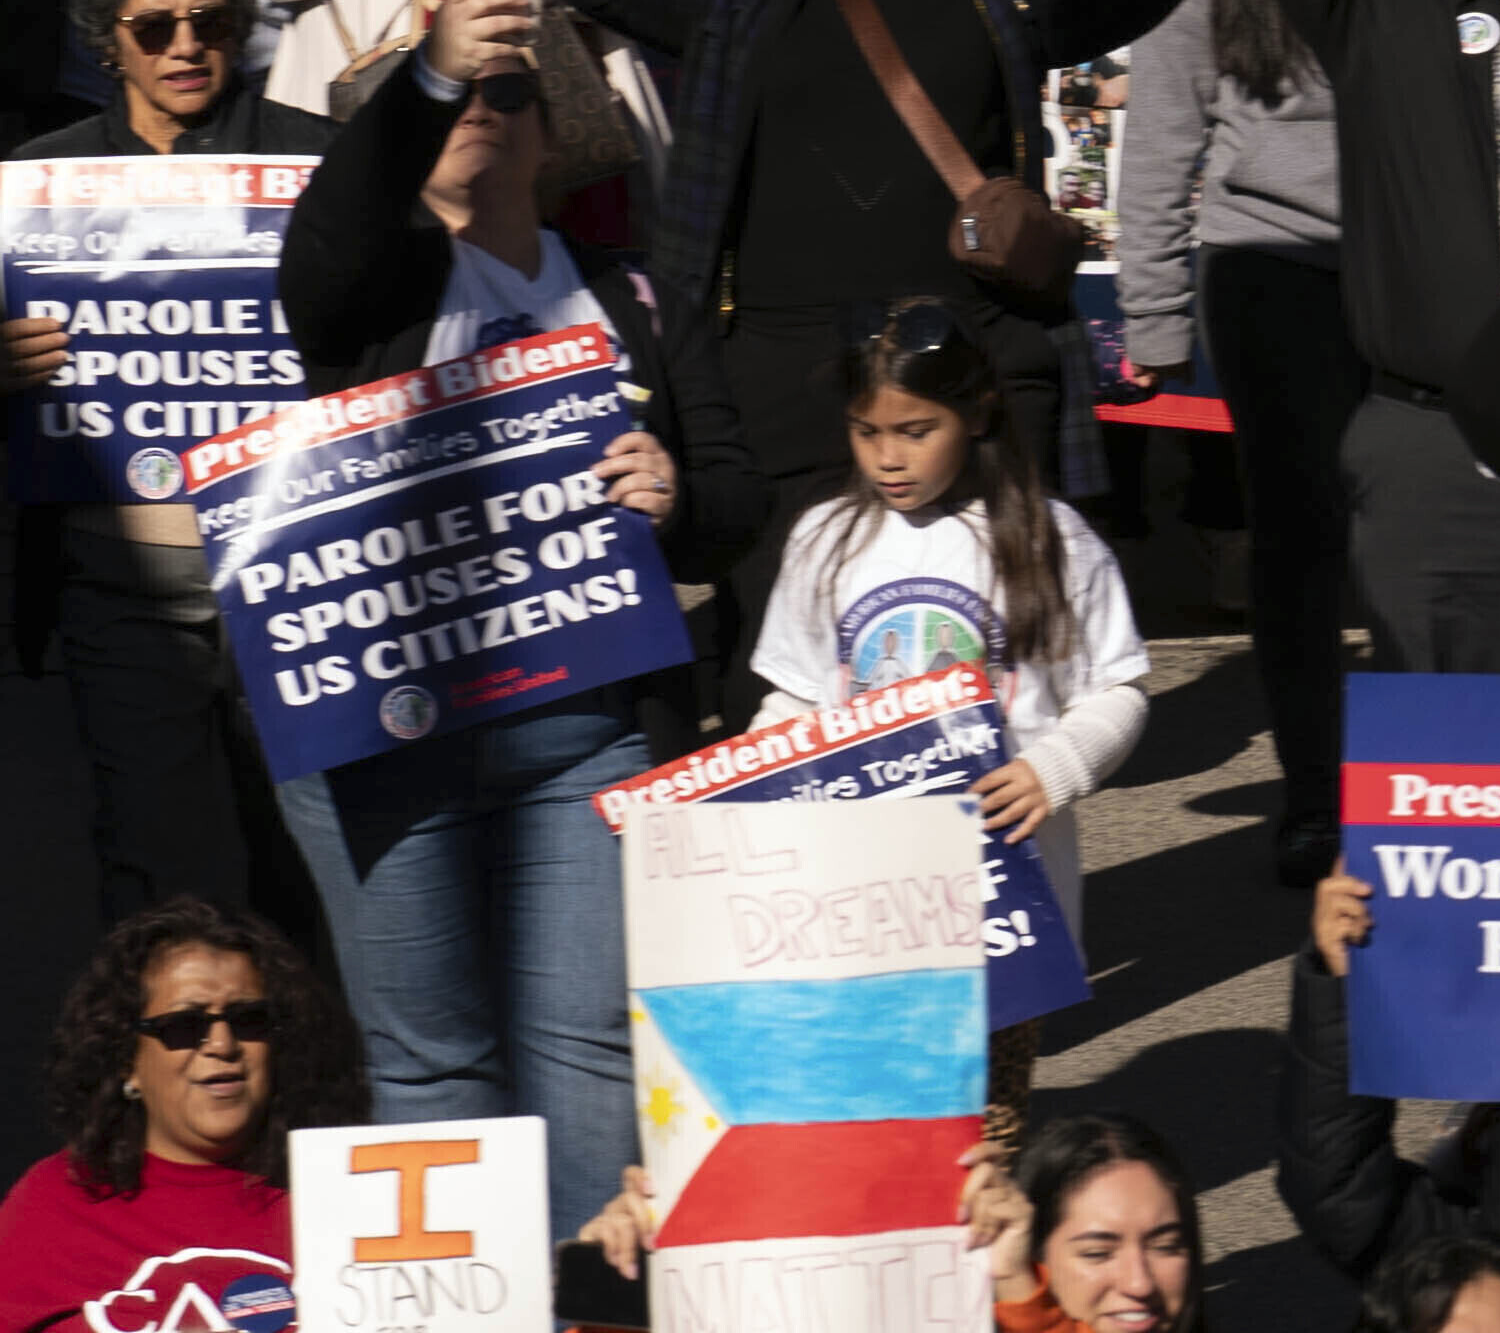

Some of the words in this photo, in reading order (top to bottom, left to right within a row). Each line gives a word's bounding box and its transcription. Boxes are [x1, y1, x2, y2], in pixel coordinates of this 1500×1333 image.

[41, 401, 113, 438] US
[51, 349, 304, 387] SPOUSES
[188, 367, 430, 483] President
[425, 339, 599, 400] Biden:
[238, 508, 480, 605] PAROLE
[485, 470, 605, 534] FOR
[266, 546, 532, 654] SPOUSES
[539, 517, 620, 572] OF
[274, 653, 356, 707] US
[362, 567, 643, 681] CITIZENS!
[601, 715, 816, 828] President
[821, 671, 980, 743] Biden:
[349, 1138, 481, 1264] I
